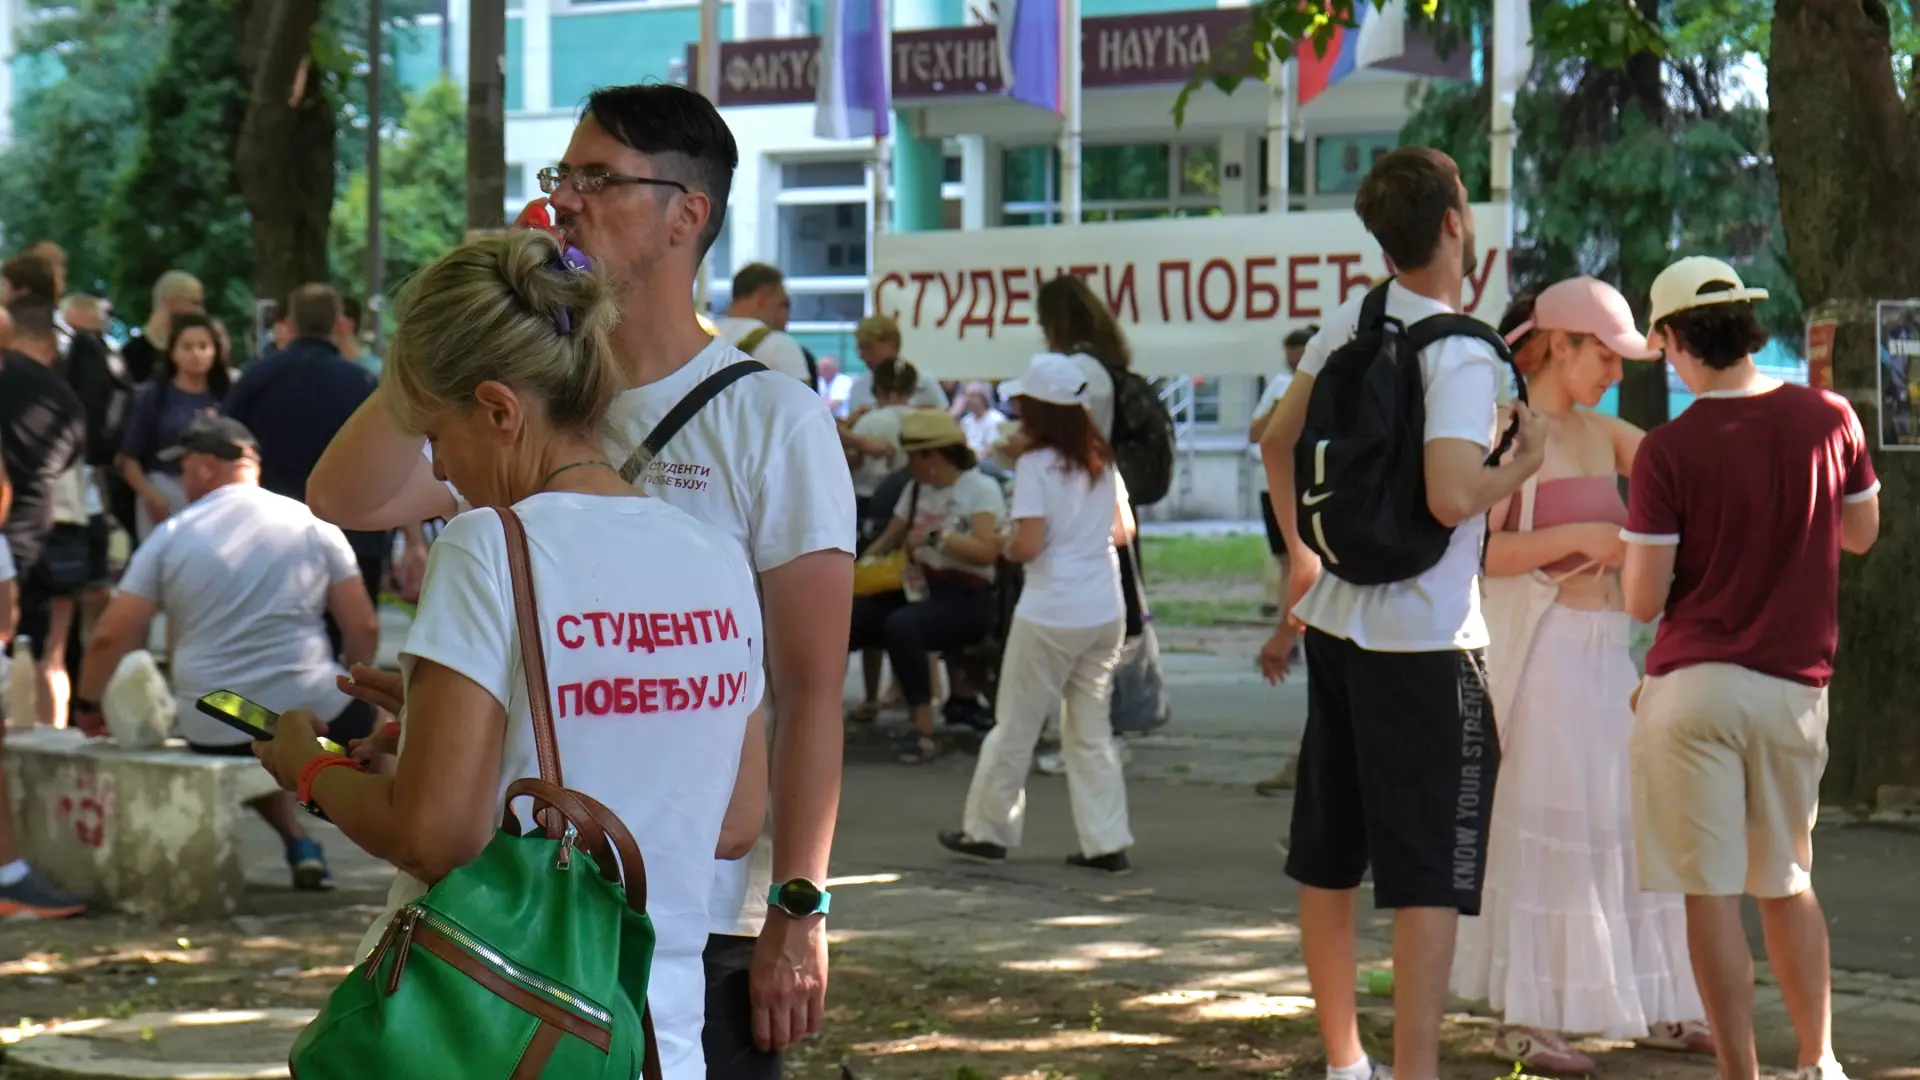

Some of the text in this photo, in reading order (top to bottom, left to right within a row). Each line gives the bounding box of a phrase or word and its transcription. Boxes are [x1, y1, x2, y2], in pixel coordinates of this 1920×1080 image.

[1099, 23, 1211, 75] НАУКА
[643, 474, 707, 491] ПОБЕЂУЈУ!
[649, 461, 711, 477] СТУДЕНТИ
[556, 607, 739, 654] СТУДЕНТИ
[557, 671, 747, 719] ПОБЕЂУЈУ!
[1456, 764, 1482, 820] YOUR
[1453, 825, 1478, 890] KNOW
